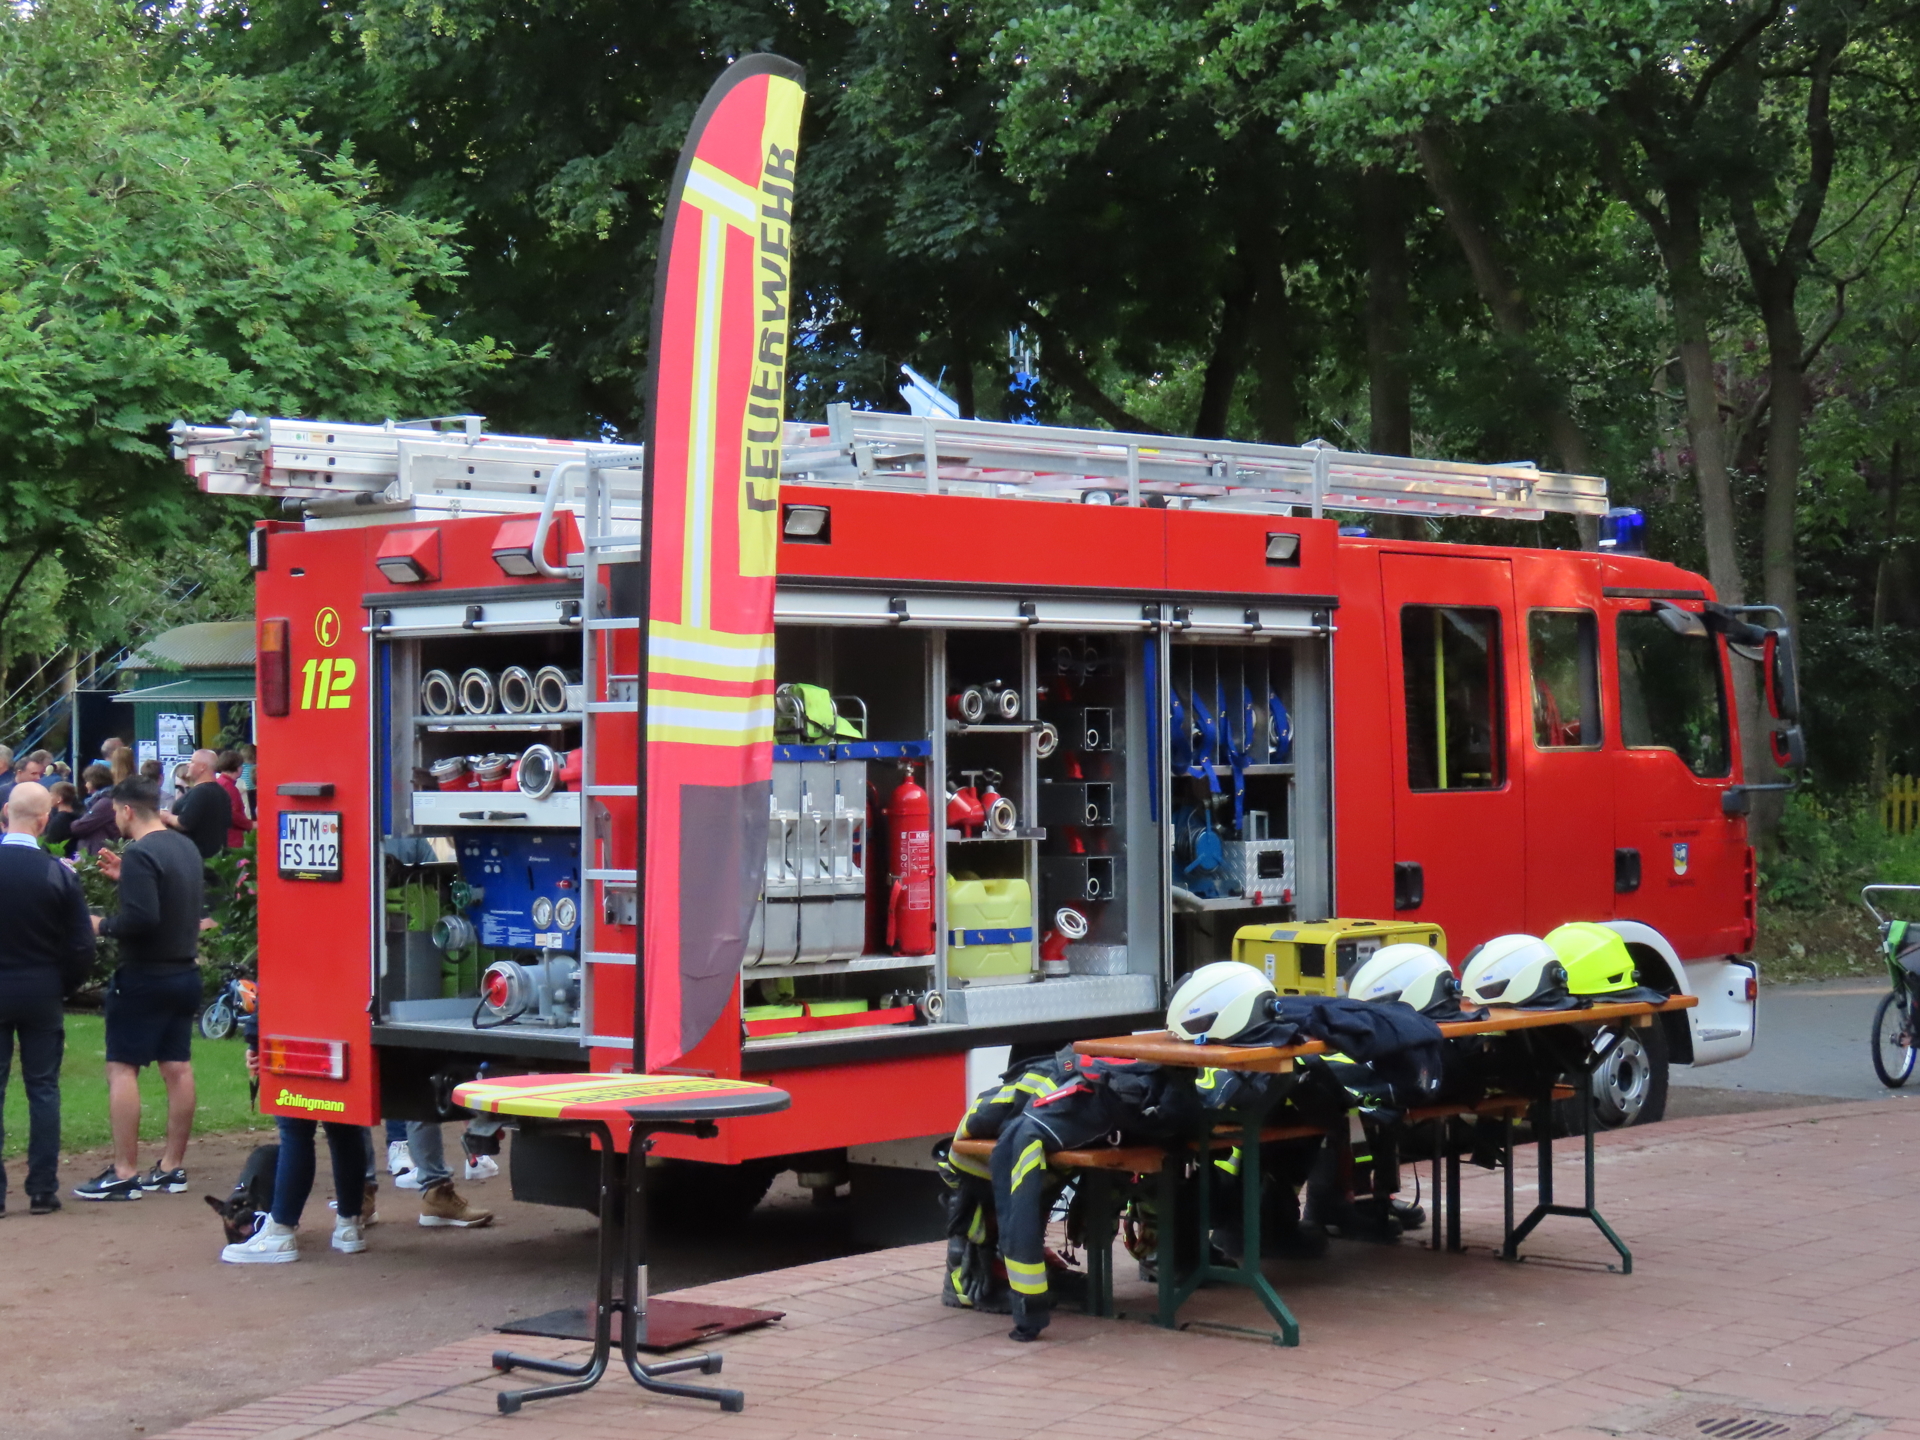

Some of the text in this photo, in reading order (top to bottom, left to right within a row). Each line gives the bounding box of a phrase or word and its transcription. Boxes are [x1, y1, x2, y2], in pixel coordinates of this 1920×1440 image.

[745, 142, 795, 512] FEUERWEHR
[300, 658, 356, 710] 112
[288, 818, 320, 841] WTM
[283, 843, 337, 867] FS 112
[275, 1089, 345, 1112] Schlingmann
